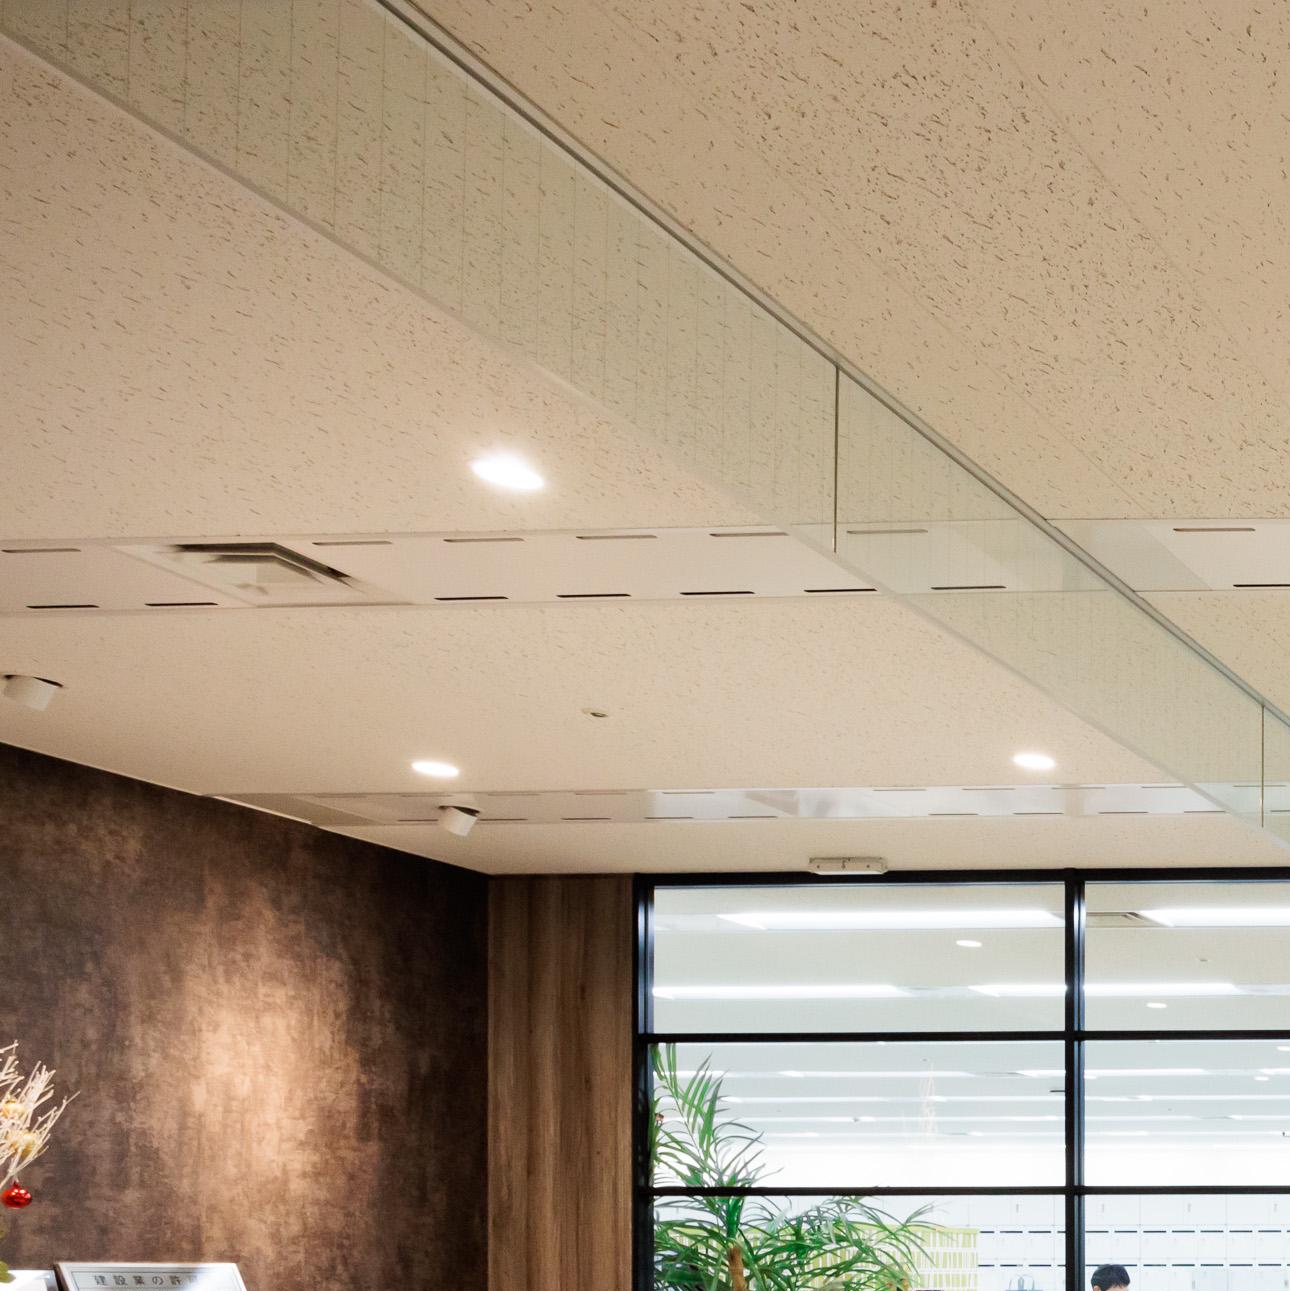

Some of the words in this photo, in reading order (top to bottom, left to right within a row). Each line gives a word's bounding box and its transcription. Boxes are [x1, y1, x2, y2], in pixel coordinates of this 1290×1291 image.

[94, 1274, 199, 1286] 建設業の許
